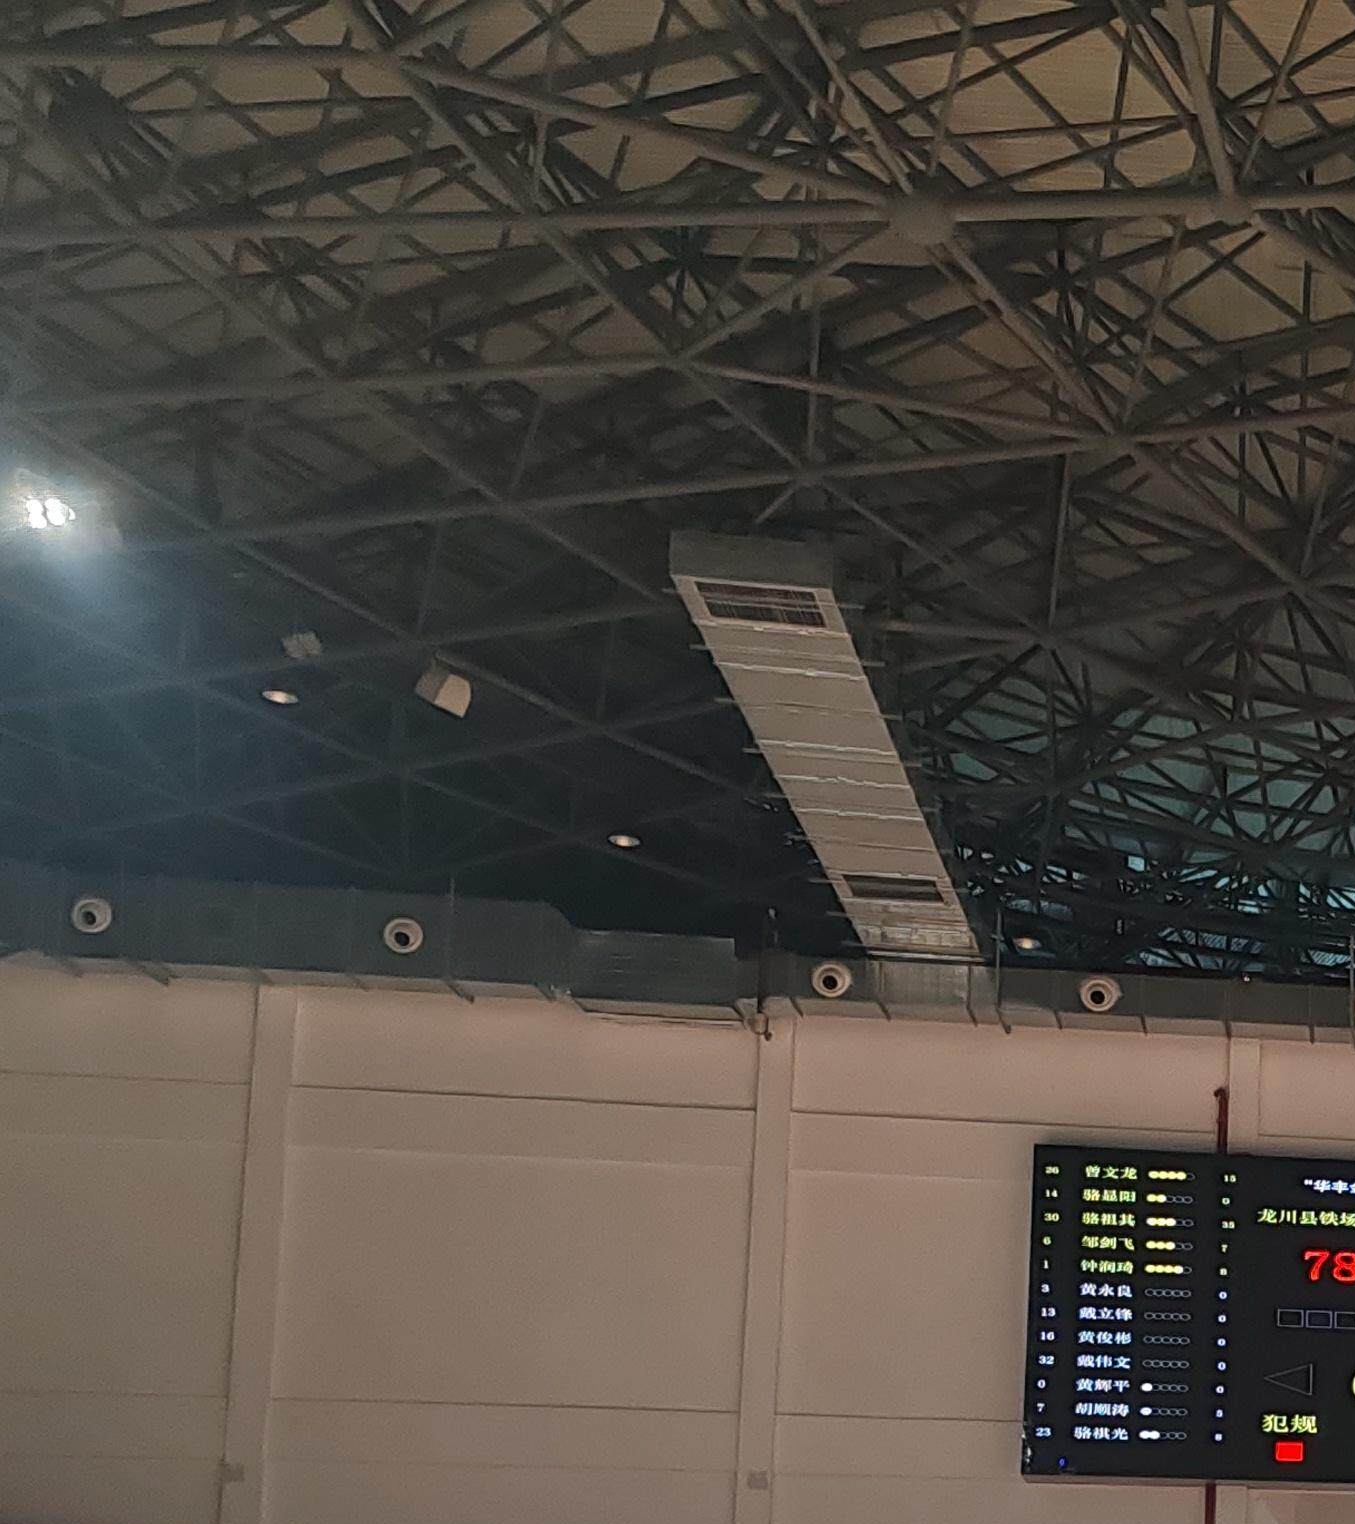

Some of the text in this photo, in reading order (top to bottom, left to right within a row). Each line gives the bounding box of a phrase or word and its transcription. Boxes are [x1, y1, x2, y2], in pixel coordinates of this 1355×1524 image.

[1045, 1189, 1058, 1198] 14
[1044, 1213, 1059, 1221] 30
[1043, 1237, 1051, 1245] 6
[1043, 1260, 1049, 1269] 1
[1041, 1284, 1050, 1293] 3
[1041, 1308, 1056, 1317] 13
[1040, 1332, 1055, 1341] 16
[1038, 1356, 1054, 1365] 32
[1037, 1380, 1046, 1389] 0
[1037, 1403, 1045, 1412] 7
[1262, 1413, 1318, 1434] 犯规
[1036, 1428, 1051, 1437] 23
